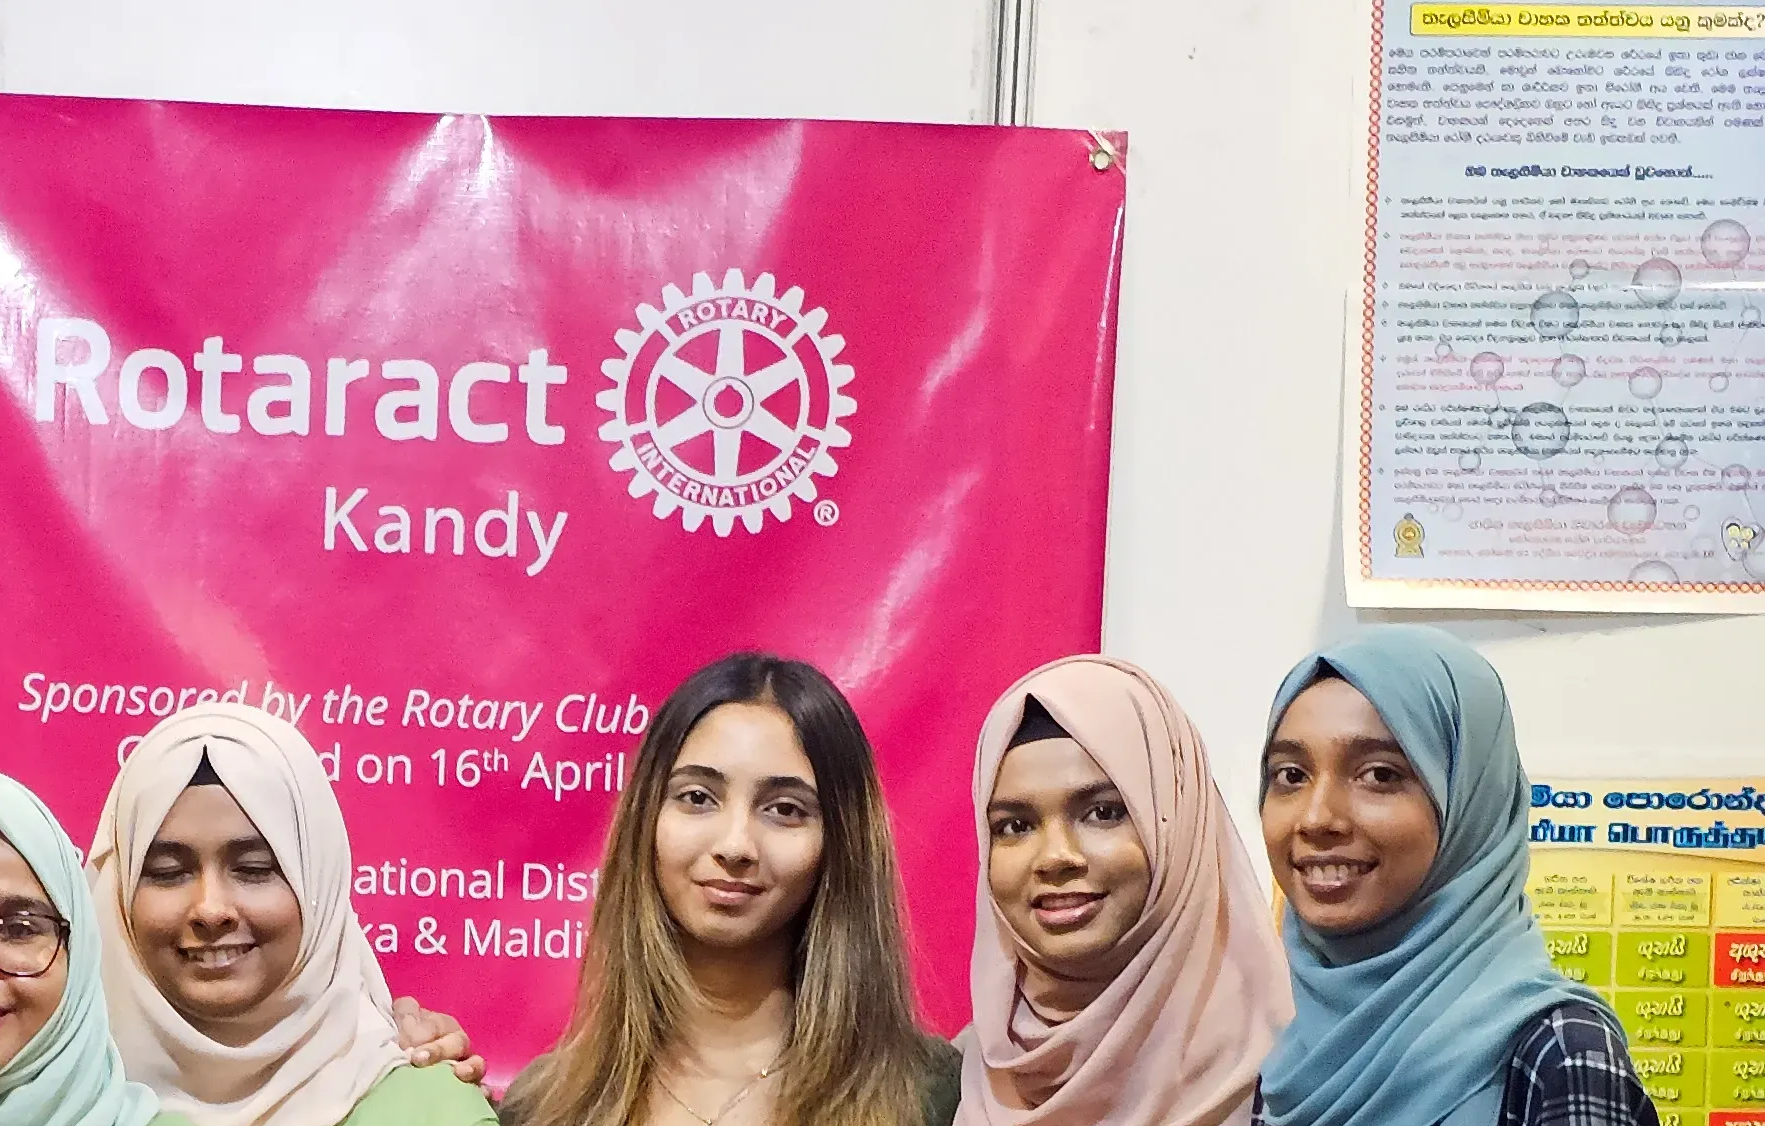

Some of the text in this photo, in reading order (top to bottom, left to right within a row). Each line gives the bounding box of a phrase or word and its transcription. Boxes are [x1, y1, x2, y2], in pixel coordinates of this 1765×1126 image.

[677, 299, 787, 331] ROTARY
[34, 317, 567, 446] Rotaract
[636, 439, 819, 507] INTERNATIONAL
[323, 486, 568, 577] Kandy
[260, 681, 312, 726] by
[322, 684, 388, 726] the
[401, 688, 544, 742] Rotary
[555, 692, 649, 735] Club
[356, 753, 412, 784] on
[430, 747, 509, 788] 16th
[520, 750, 625, 802] April
[1602, 785, 1765, 815] පොරොන්ද
[354, 857, 601, 902] ational Dist
[414, 917, 448, 956] &
[462, 917, 583, 959] Maldi
